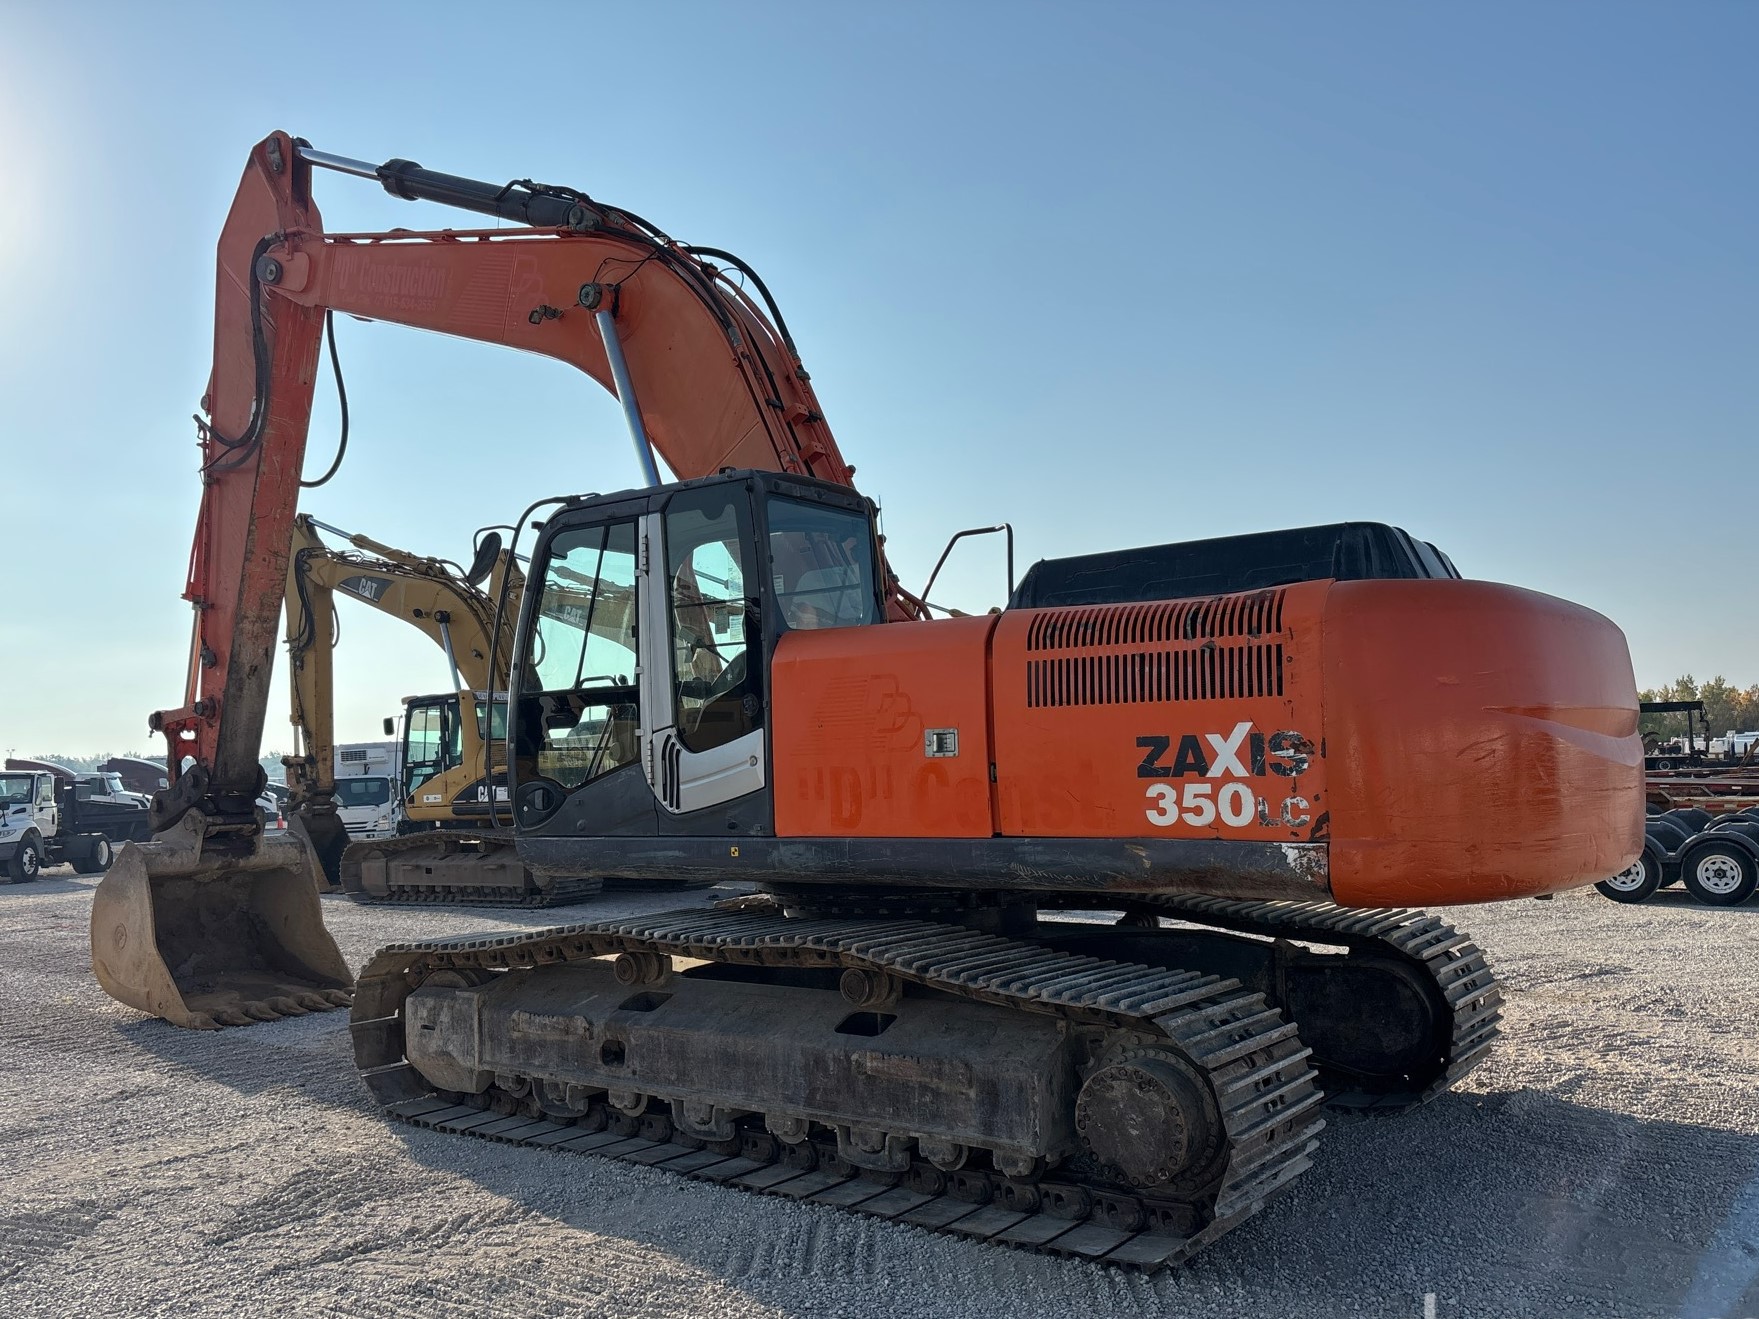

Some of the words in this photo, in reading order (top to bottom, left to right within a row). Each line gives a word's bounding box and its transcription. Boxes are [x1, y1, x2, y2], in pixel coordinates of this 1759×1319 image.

[358, 577, 378, 599] CAT
[563, 606, 583, 624] CAT
[1135, 721, 1314, 778] ZAXIS
